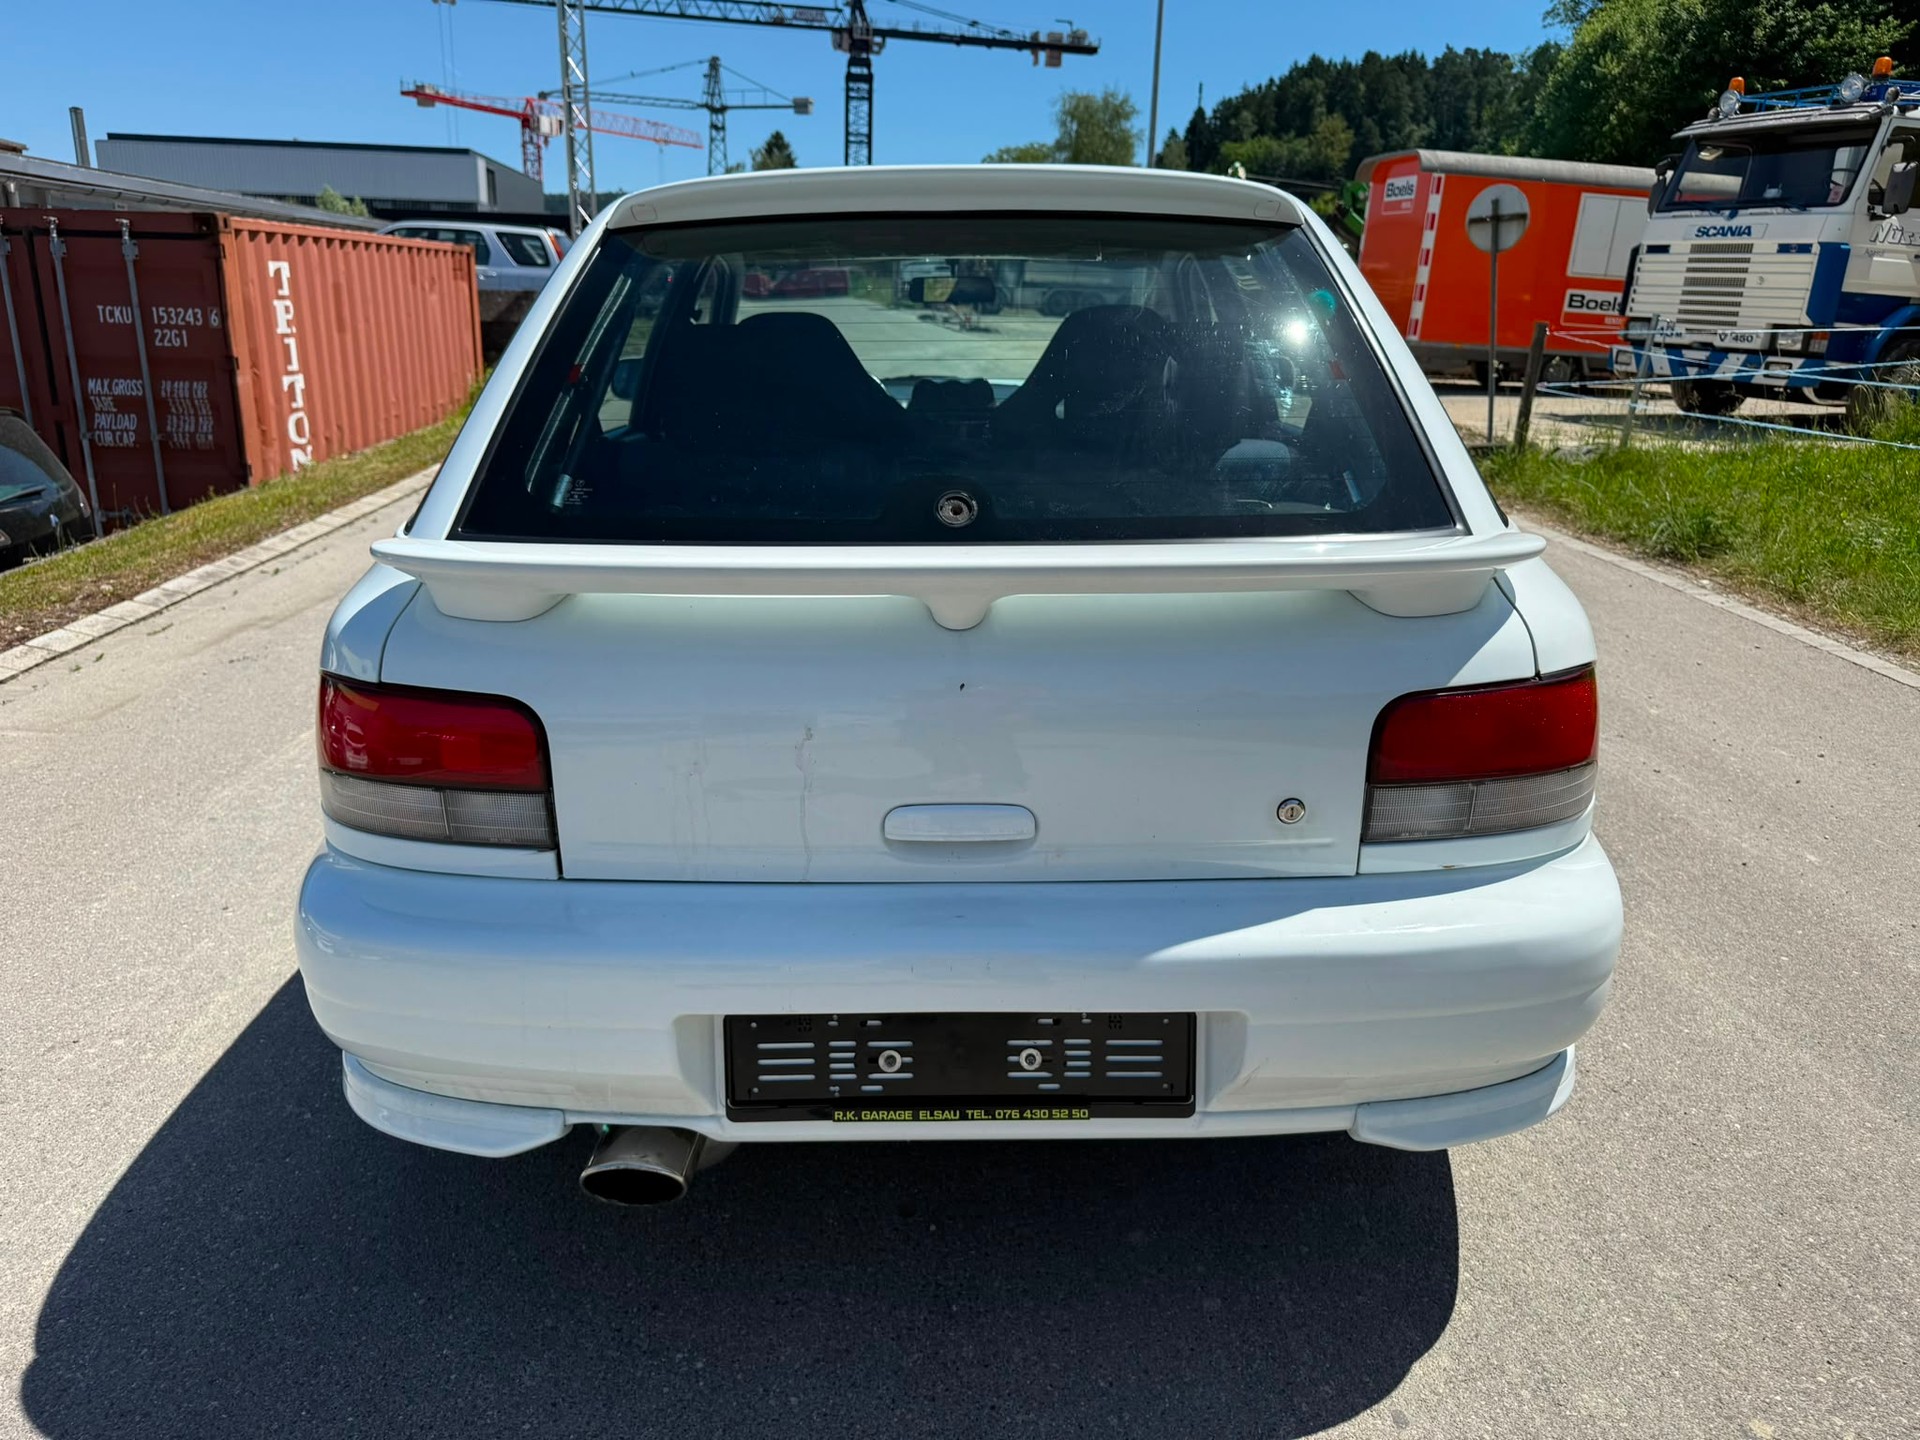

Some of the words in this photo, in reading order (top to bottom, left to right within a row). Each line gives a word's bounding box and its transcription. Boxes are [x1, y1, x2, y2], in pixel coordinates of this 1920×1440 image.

[1386, 180, 1415, 198] Boels
[1694, 225, 1752, 238] SCANIA
[97, 305, 133, 324] TCKU
[152, 306, 203, 326] 153243
[209, 309, 220, 327] 6
[154, 328, 188, 347] 22G1
[268, 260, 313, 472] TRITON
[89, 396, 118, 412] TARE
[94, 412, 137, 430] PAYLOAD
[834, 1110, 858, 1120] R.K.
[861, 1110, 913, 1120] GARAGE
[919, 1110, 960, 1120] ELSAU
[966, 1109, 992, 1119] TEL.
[995, 1109, 1020, 1119] 076
[1023, 1109, 1049, 1119] 430
[1052, 1109, 1069, 1119] 52
[1072, 1109, 1089, 1119] 50
